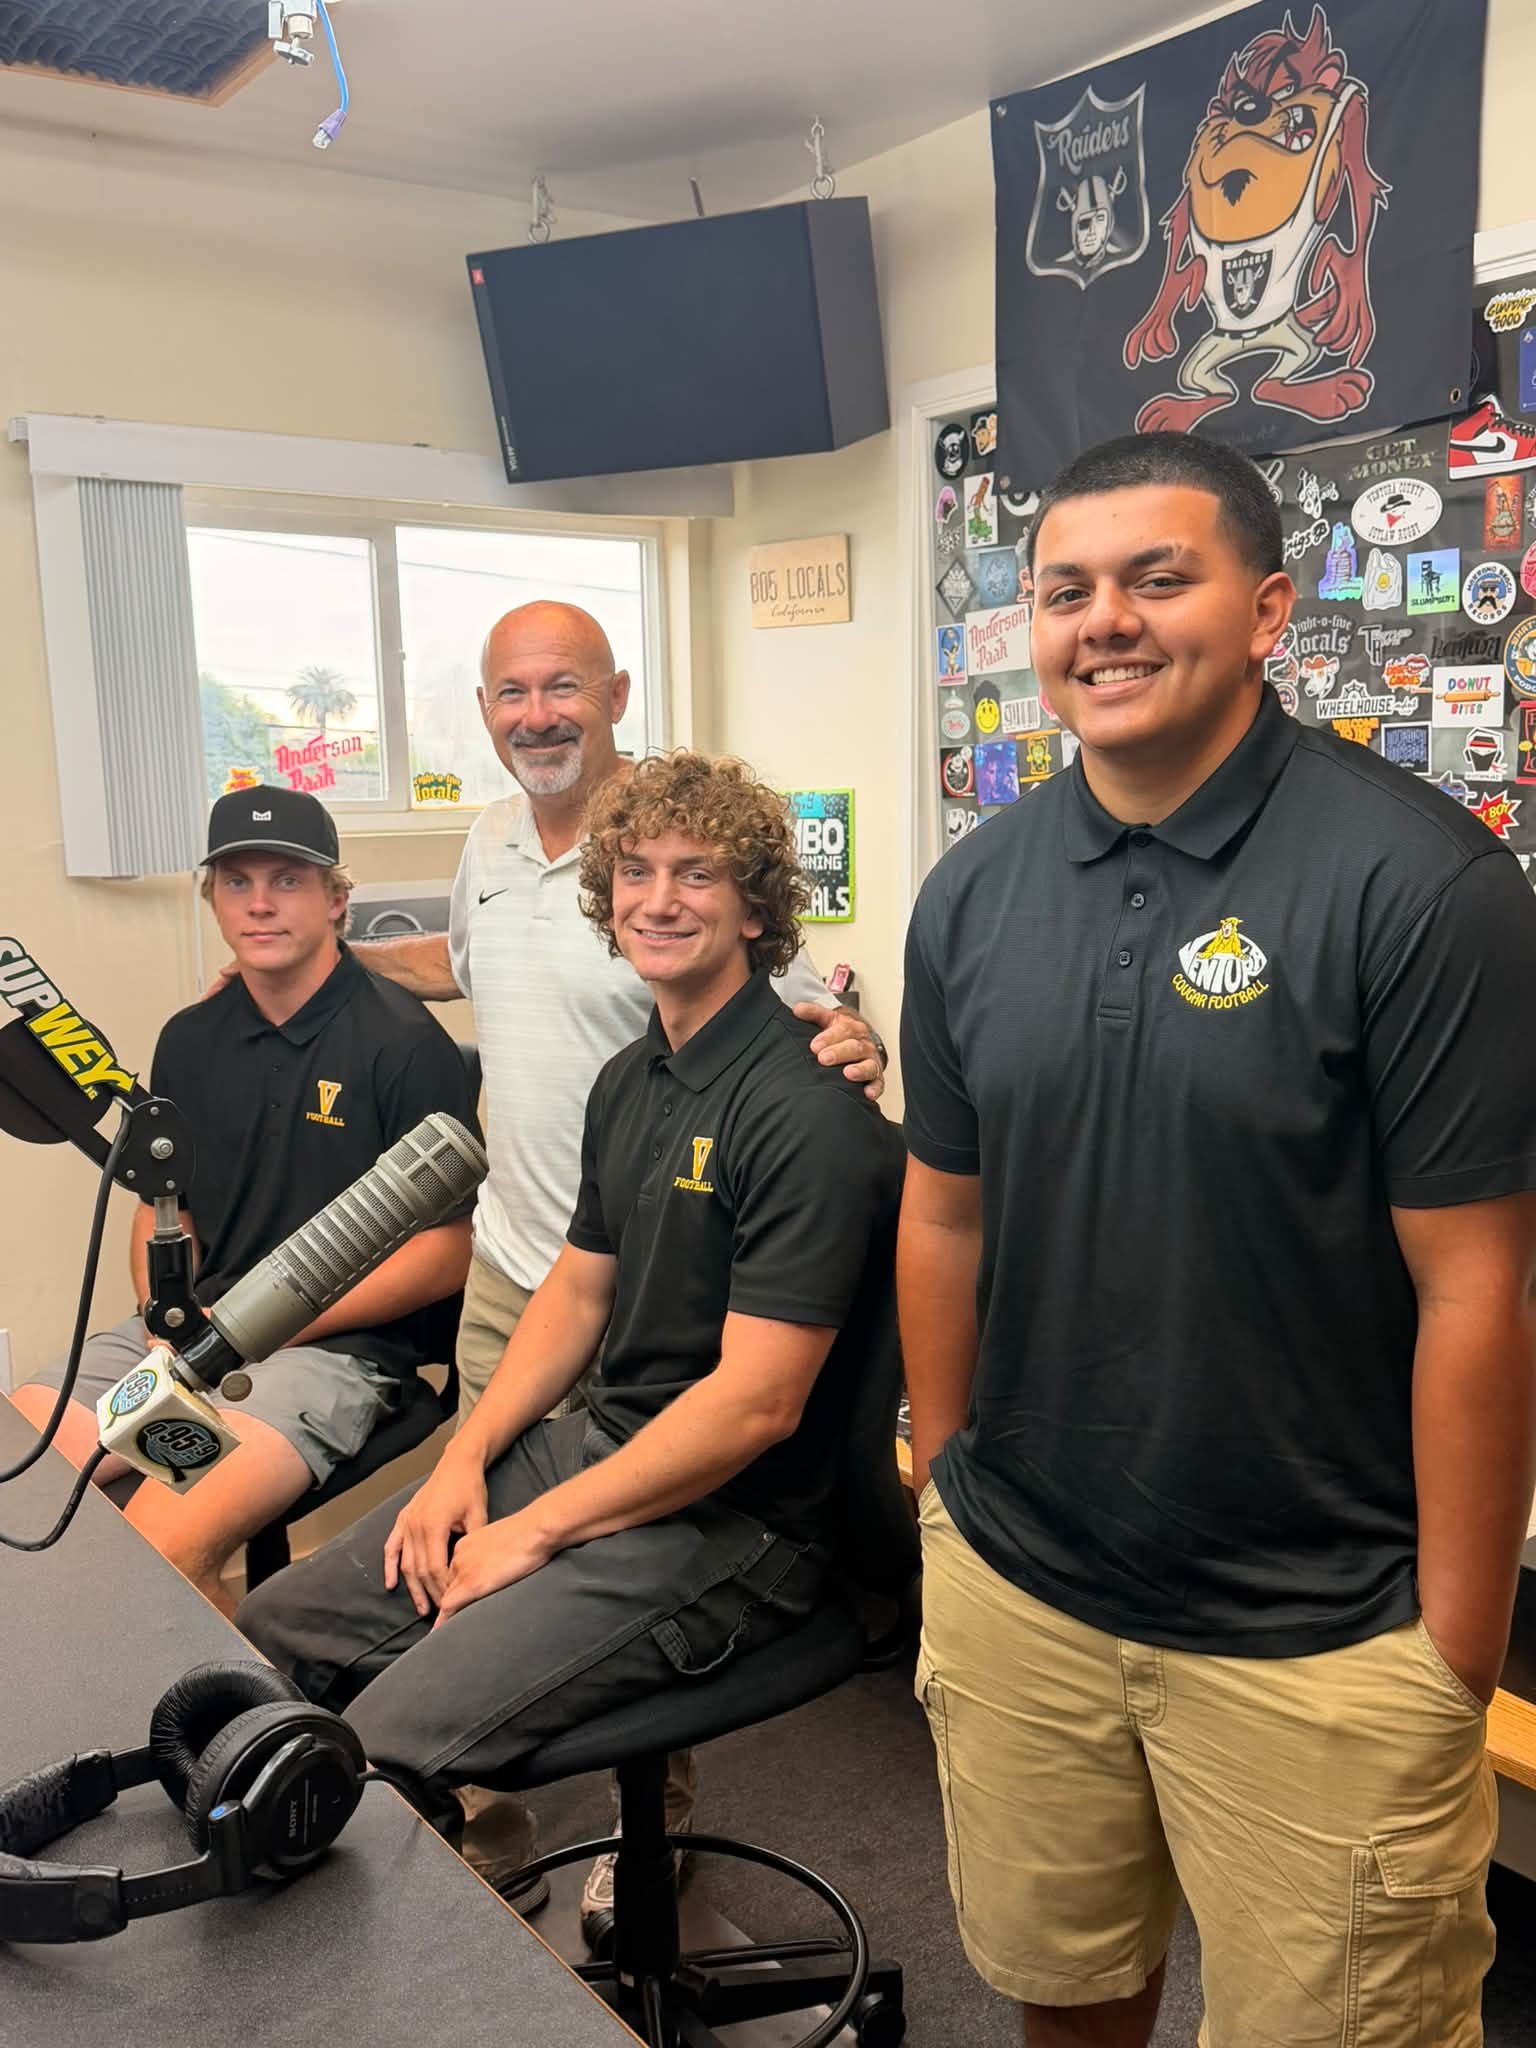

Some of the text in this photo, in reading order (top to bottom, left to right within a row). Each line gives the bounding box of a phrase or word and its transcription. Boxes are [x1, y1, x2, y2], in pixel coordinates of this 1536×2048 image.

[1047, 114, 1130, 176] Raiders
[1225, 252, 1268, 270] RAIDERS
[786, 561, 846, 601] LOCALS
[771, 602, 825, 622] California
[968, 608, 1027, 651] Anderson
[1447, 676, 1492, 691] DONUT
[1319, 698, 1394, 717] WHEELHOUSE
[1451, 703, 1483, 715] BITES
[274, 734, 363, 773] Anderson
[1171, 973, 1270, 1010] COUGAR FOOTBALL
[317, 1079, 343, 1116] V
[306, 1111, 345, 1127] FOOTBALL
[692, 1136, 714, 1180] V
[673, 1176, 714, 1193] FOOTBALL
